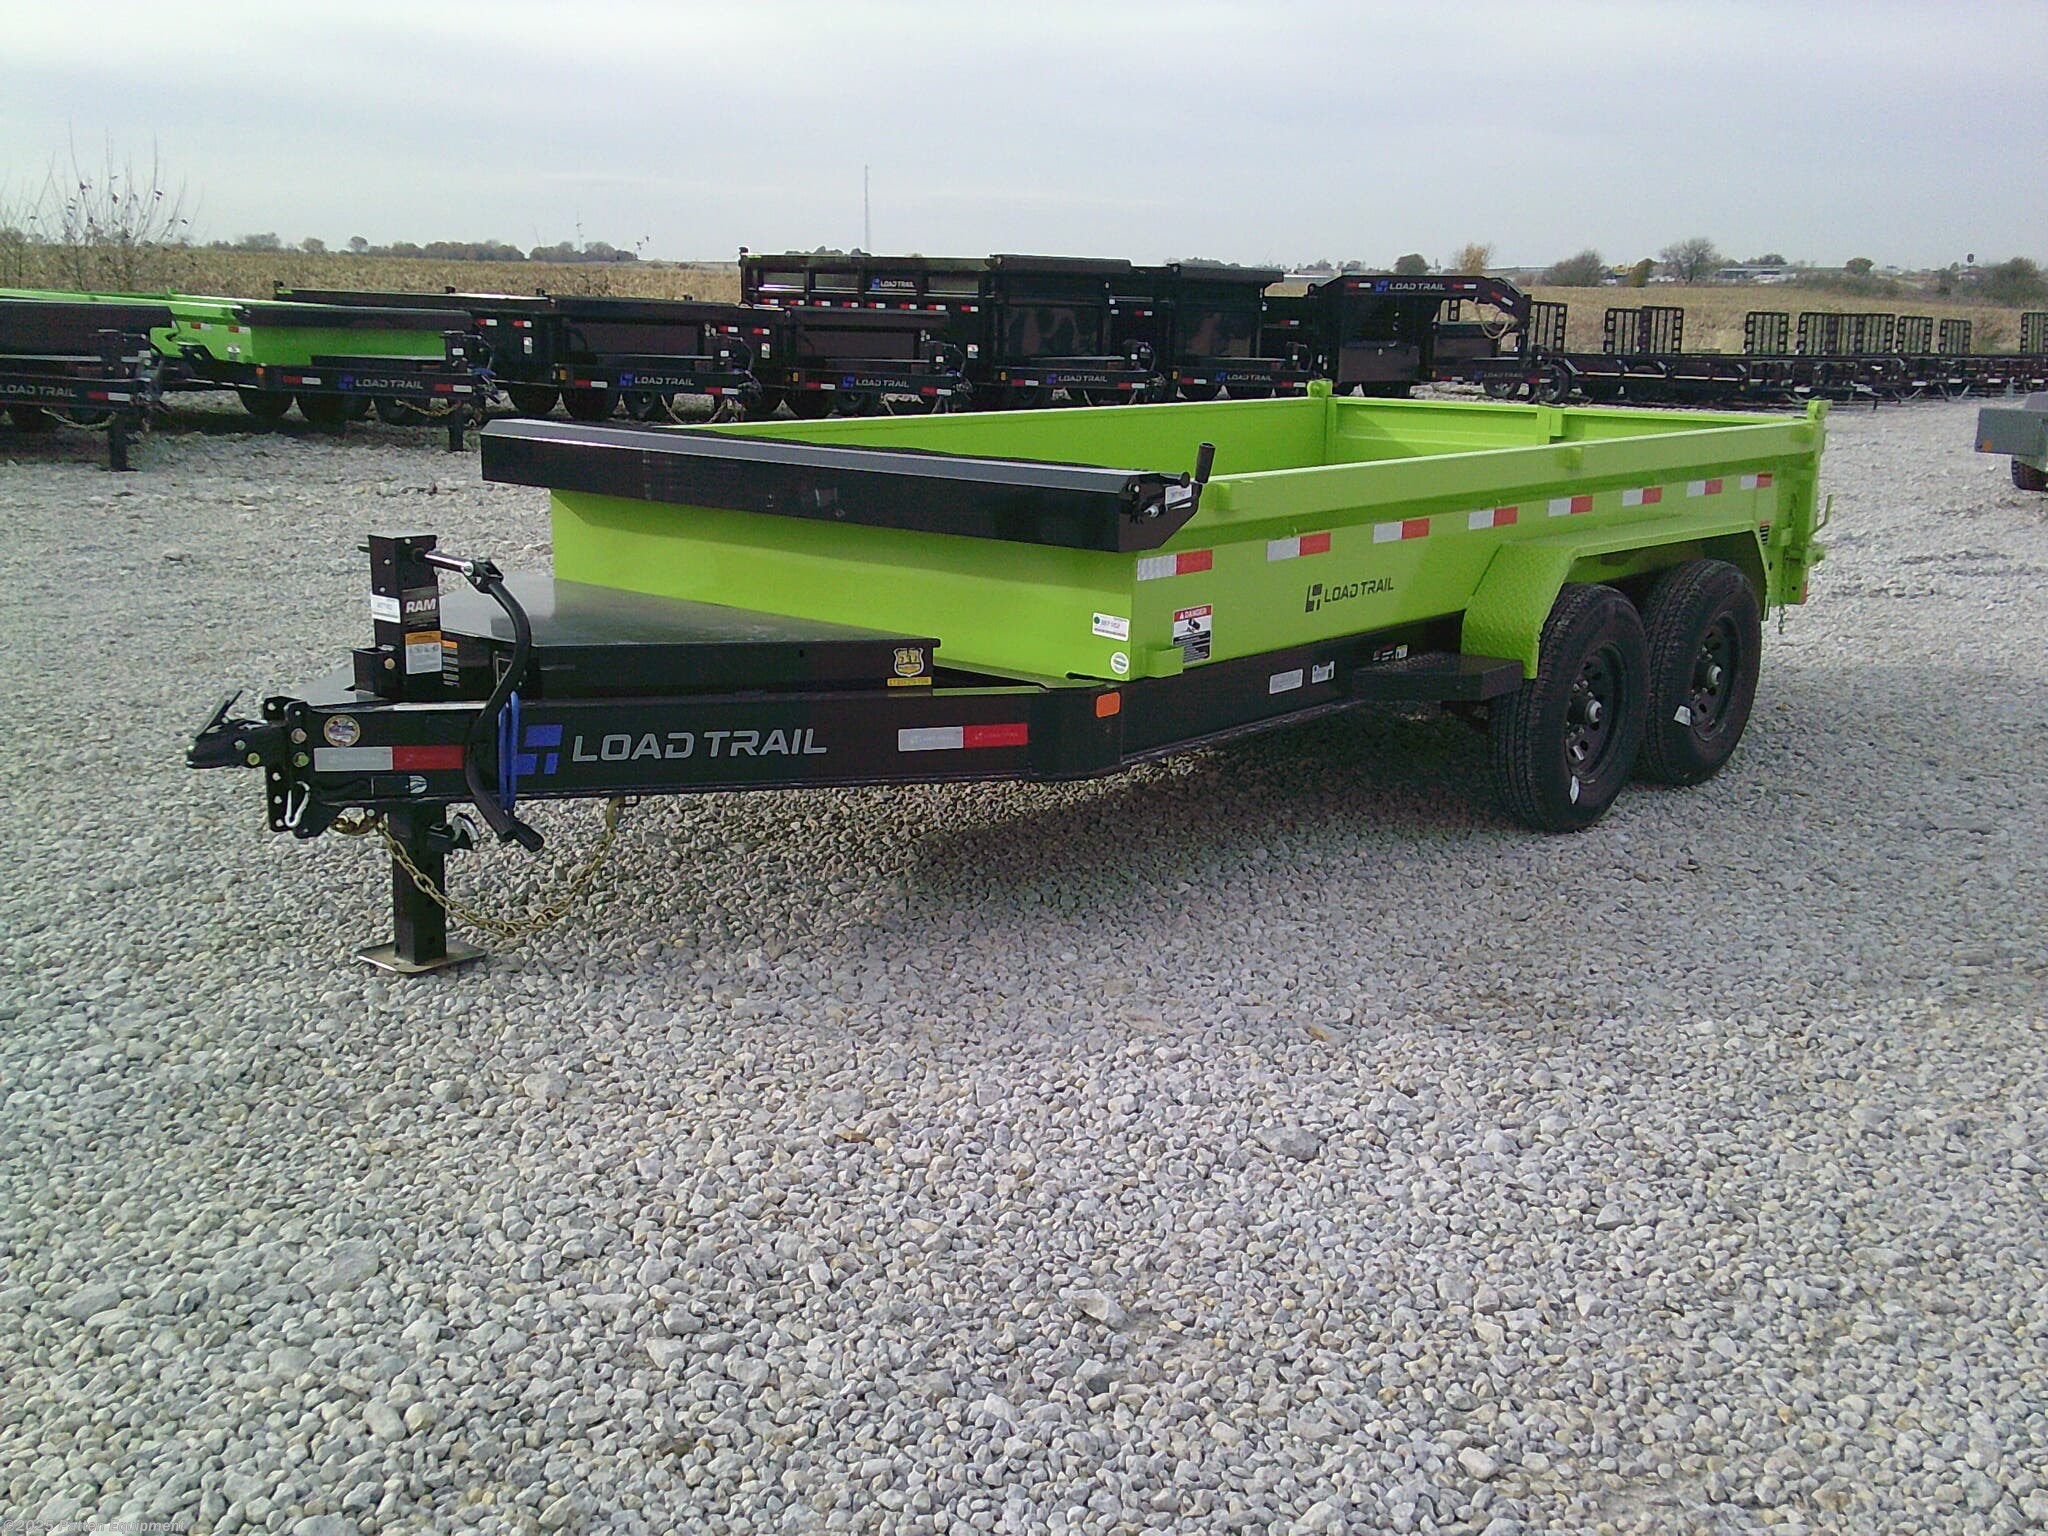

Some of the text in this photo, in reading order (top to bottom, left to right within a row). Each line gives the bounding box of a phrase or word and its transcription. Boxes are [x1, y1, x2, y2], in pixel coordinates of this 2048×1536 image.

[356, 379, 424, 390] LOAD TRAIL
[635, 376, 695, 386] LOAD TRAIL
[856, 379, 910, 388] LOAD TRAIL
[0, 384, 78, 398] LOAD TRAIL
[1324, 577, 1394, 603] LOAD TRAIL
[406, 598, 437, 613] RAM
[573, 728, 828, 762] LOAD TRAIL
